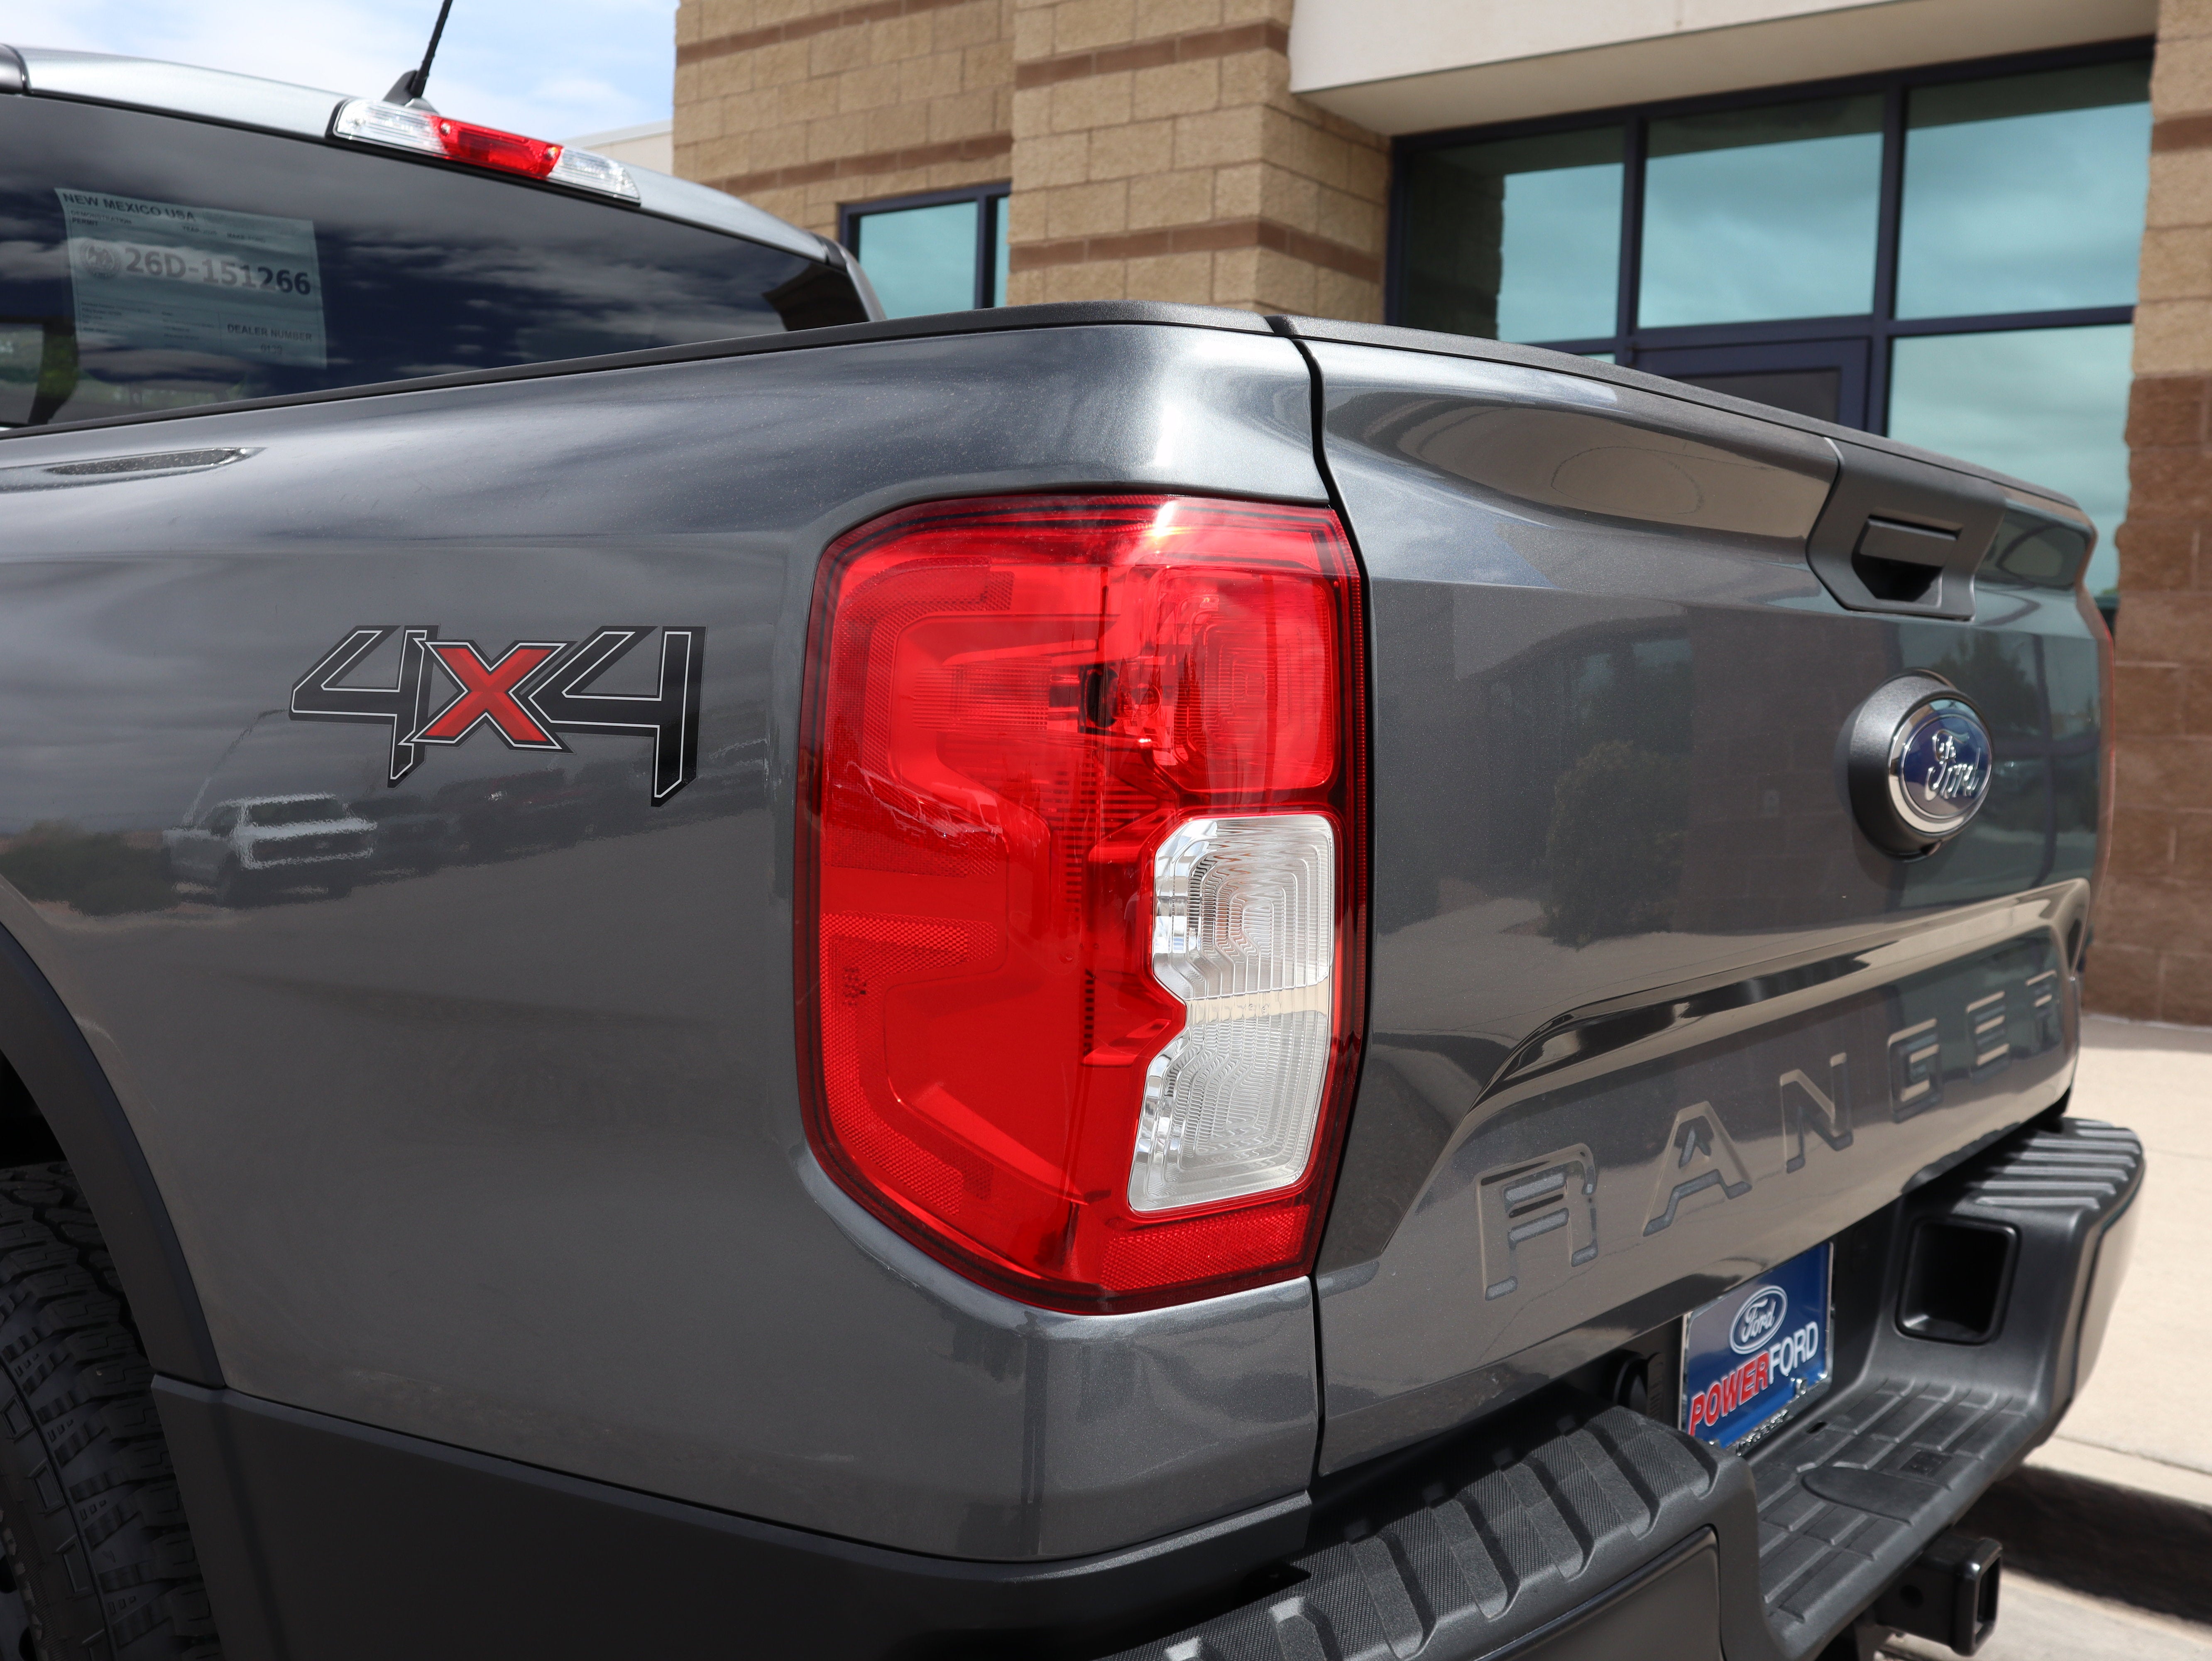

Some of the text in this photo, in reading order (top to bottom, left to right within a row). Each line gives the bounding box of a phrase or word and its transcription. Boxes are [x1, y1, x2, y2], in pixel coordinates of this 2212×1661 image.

[62, 193, 197, 221] NEW MEXICO USA
[124, 246, 311, 296] 26D-151266
[227, 323, 312, 342] DEALER NUMBER
[1475, 969, 2064, 1301] RANGER
[1740, 1297, 1776, 1343] Ford
